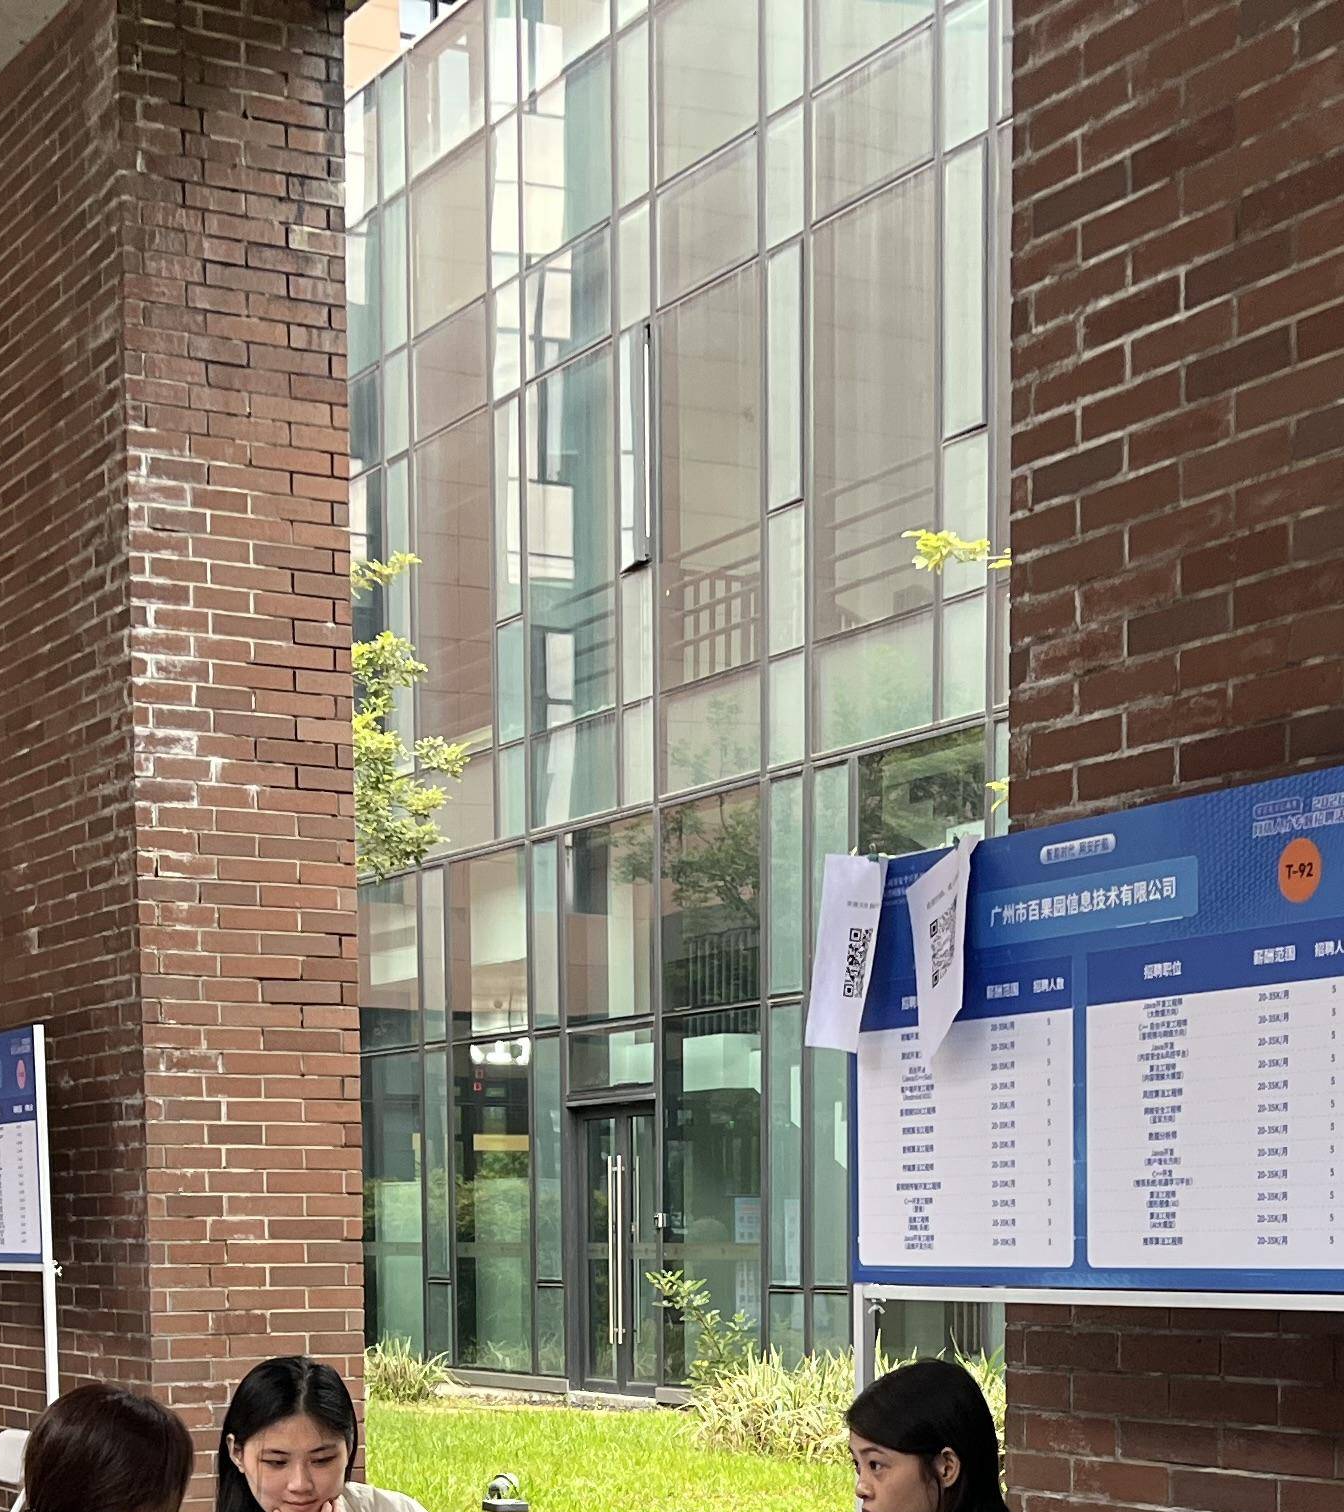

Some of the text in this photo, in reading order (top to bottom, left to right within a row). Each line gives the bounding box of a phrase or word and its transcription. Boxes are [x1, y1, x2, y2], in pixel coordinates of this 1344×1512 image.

[1285, 862, 1315, 880] T-92
[990, 876, 1177, 928] 广州市百果园信息技术有限公司
[1144, 961, 1182, 980] 招聘职位
